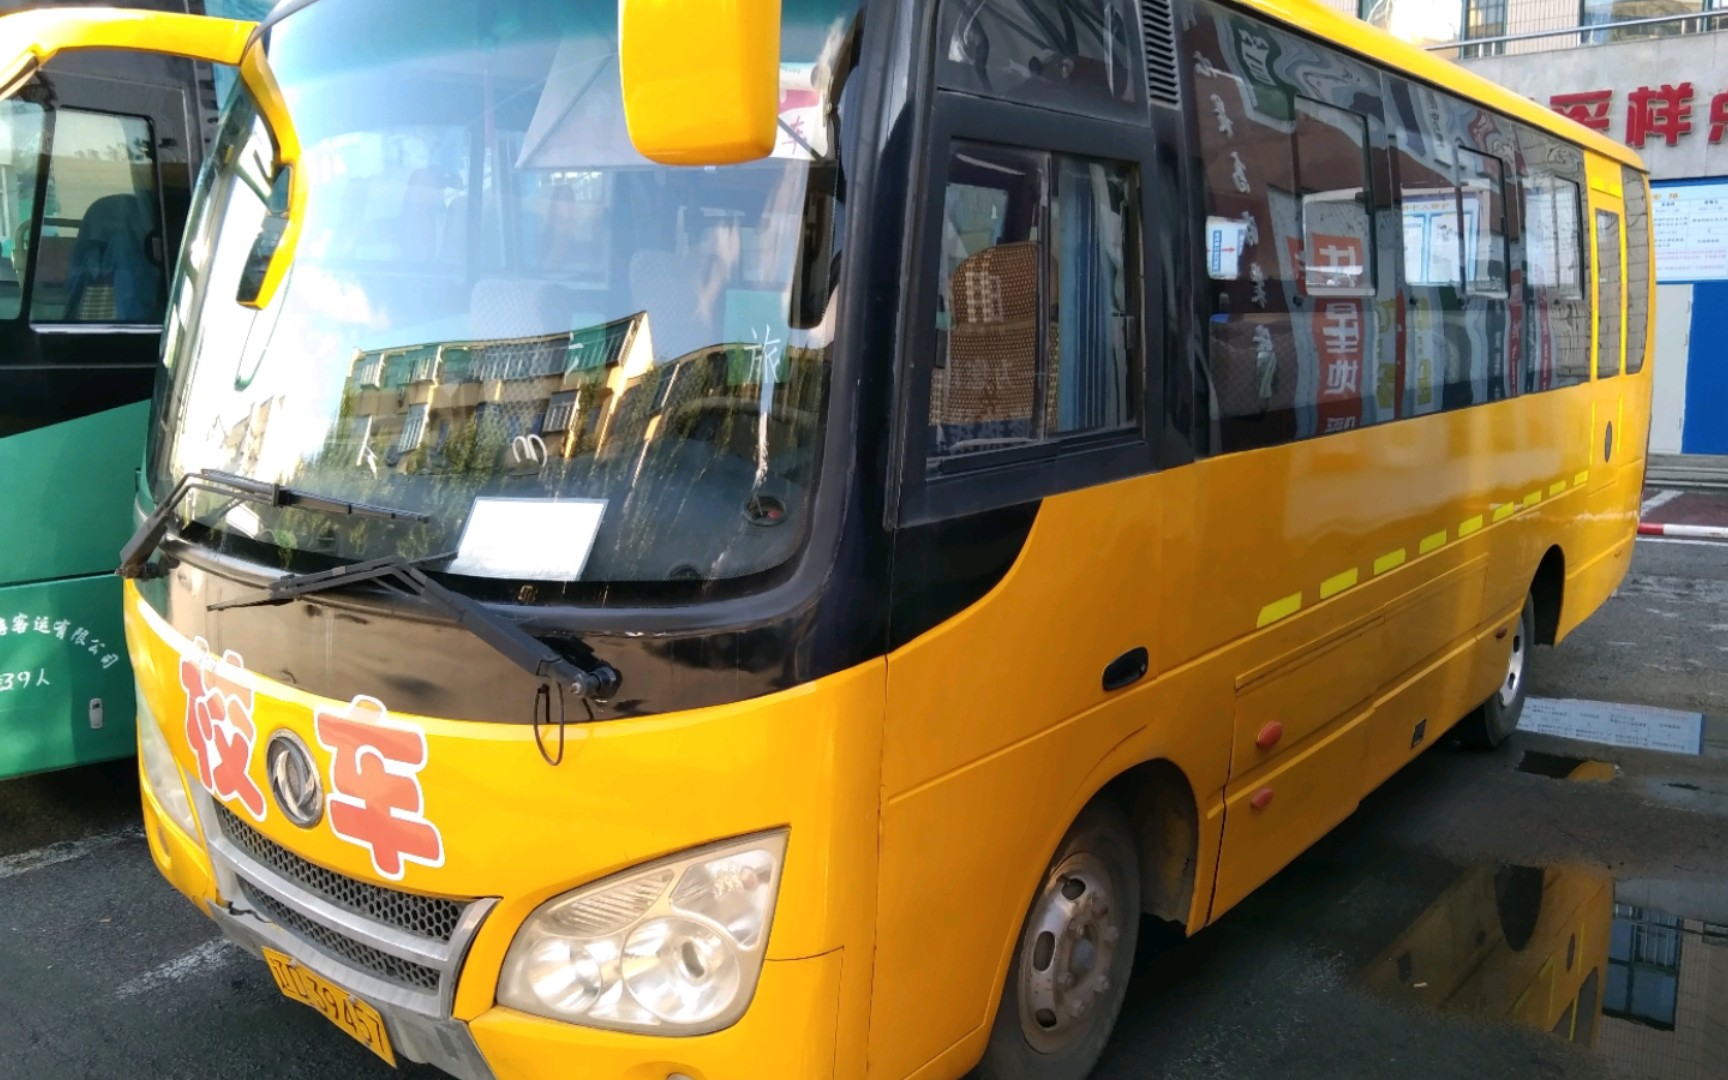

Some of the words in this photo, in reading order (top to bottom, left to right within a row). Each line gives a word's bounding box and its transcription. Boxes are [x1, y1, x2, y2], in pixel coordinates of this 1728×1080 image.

[1549, 82, 1728, 148] 采样
[179, 635, 446, 882] 校车
[269, 957, 386, 1054] 辽D39457
